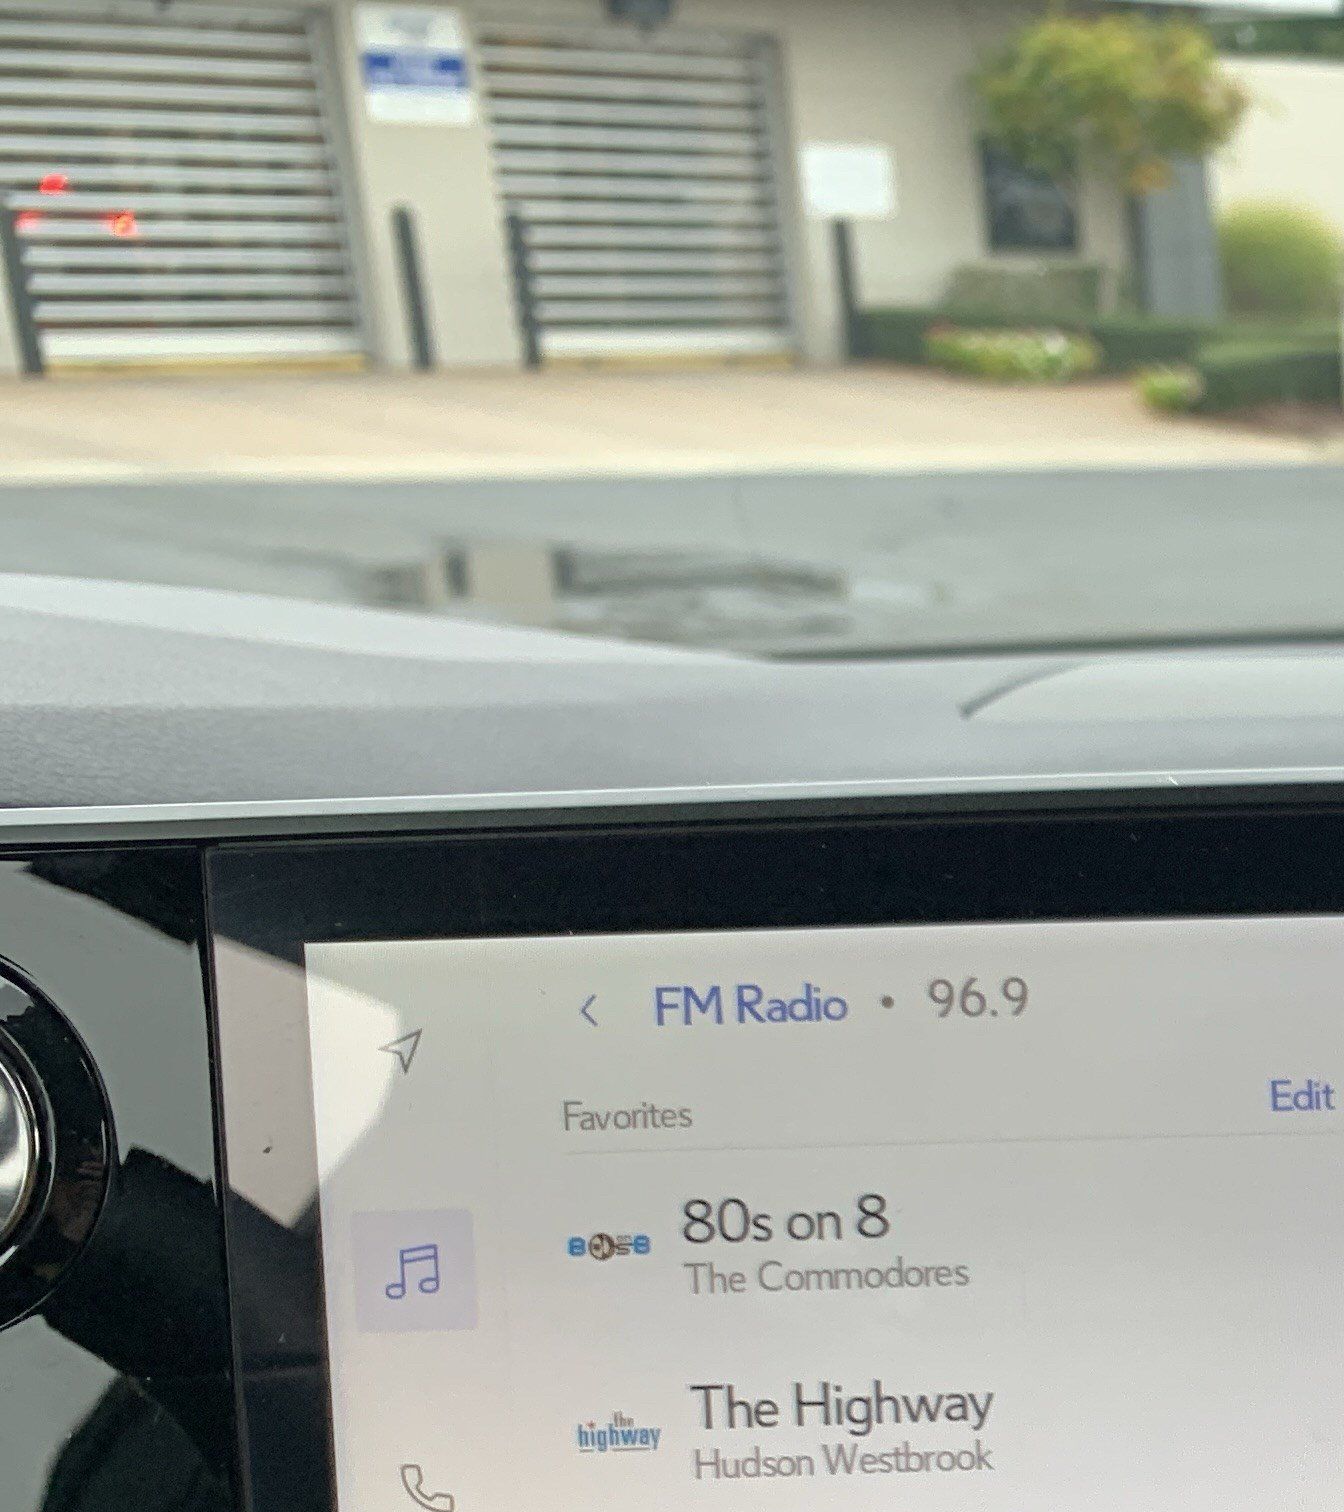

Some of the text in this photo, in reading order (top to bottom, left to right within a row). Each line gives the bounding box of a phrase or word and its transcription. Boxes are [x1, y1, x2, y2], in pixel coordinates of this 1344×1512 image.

[655, 982, 848, 1026] FM Radio
[927, 976, 1029, 1018] 96.9
[563, 1101, 693, 1131] Favorites
[1270, 1079, 1336, 1112] Edit
[683, 1193, 890, 1243] 80s on 8
[684, 1256, 970, 1295] The Commodores
[690, 1379, 995, 1436] The Highway
[577, 1423, 661, 1452] highway
[694, 1439, 996, 1480] Hudson Westbrook
